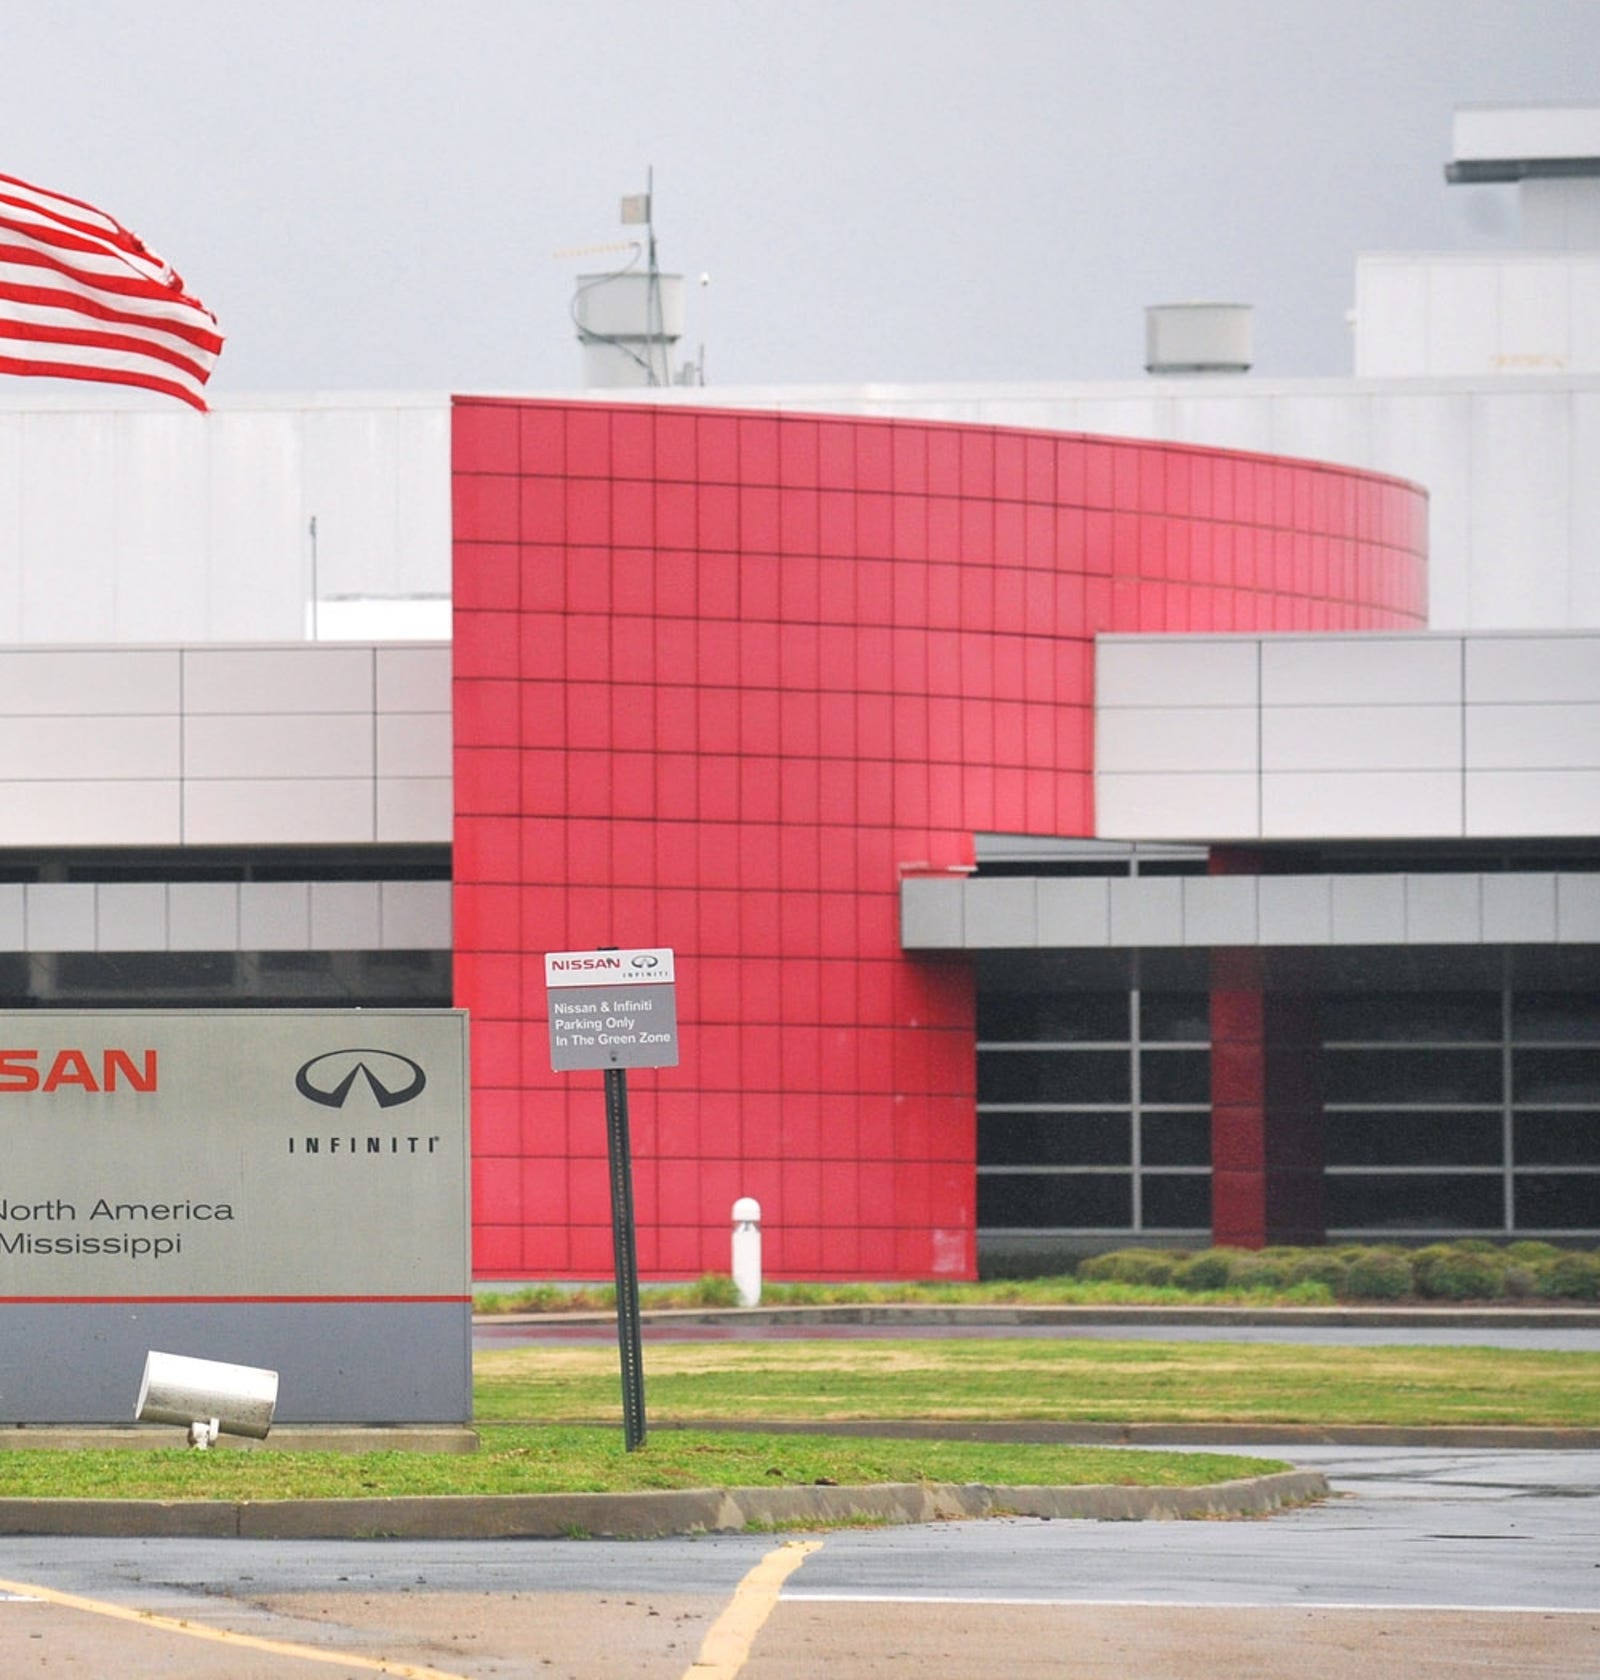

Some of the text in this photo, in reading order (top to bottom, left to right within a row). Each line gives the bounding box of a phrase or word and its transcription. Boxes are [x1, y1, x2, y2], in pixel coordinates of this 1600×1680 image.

[551, 957, 621, 971] NISSAN
[622, 970, 669, 978] INFINITI
[554, 1000, 653, 1014] Nissan & Infiniti
[555, 1017, 636, 1031] Parking Only
[556, 1032, 672, 1046] In The Green Zone
[89, 1198, 235, 1221] America
